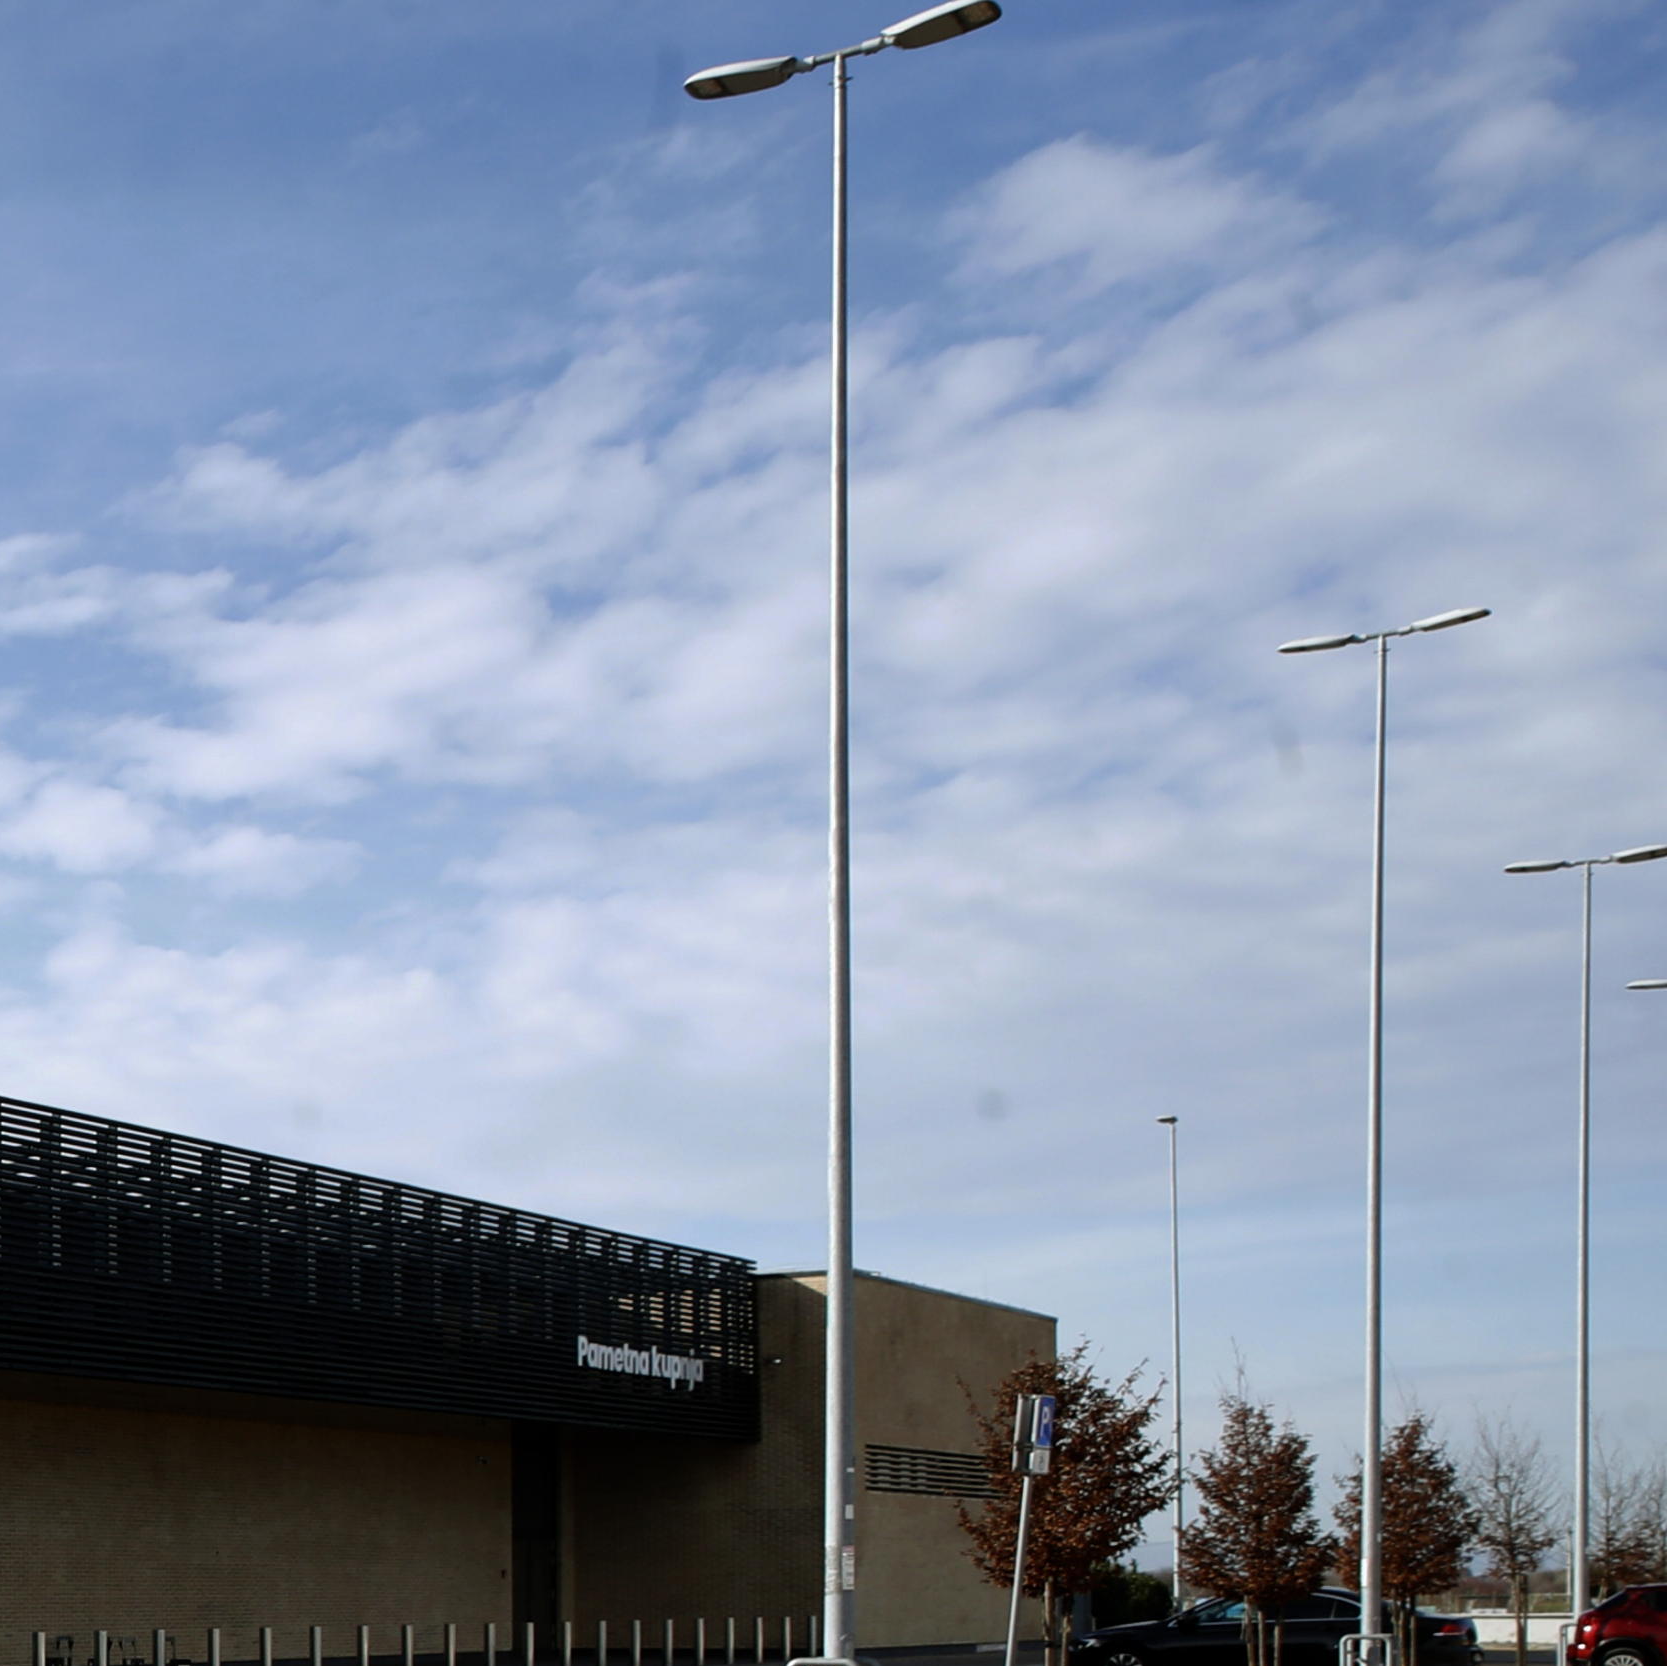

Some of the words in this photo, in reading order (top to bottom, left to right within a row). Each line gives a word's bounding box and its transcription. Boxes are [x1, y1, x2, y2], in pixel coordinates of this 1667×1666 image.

[577, 1334, 650, 1376] Pametna
[651, 1345, 704, 1392] kupnja
[1040, 1406, 1051, 1438] P
